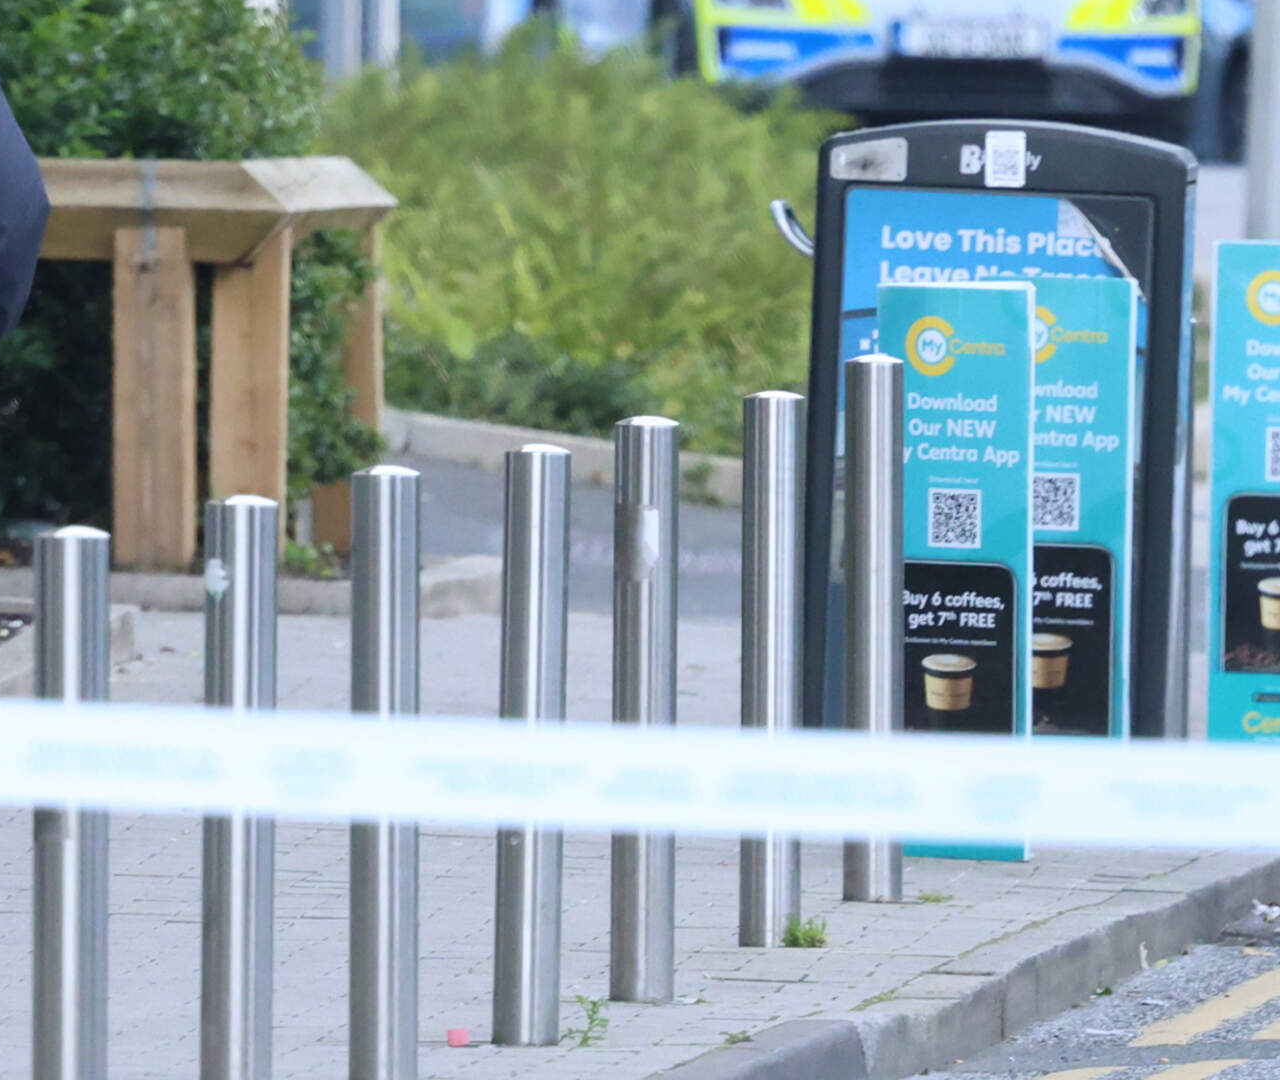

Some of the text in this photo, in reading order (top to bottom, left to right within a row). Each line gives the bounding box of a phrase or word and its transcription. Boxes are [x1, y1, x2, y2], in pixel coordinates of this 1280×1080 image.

[881, 224, 952, 251] Love
[957, 228, 1022, 255] This
[879, 260, 970, 282] Leave
[1051, 325, 1109, 344] Centra
[921, 337, 1006, 357] My Centra
[907, 392, 999, 413] Download
[1222, 384, 1250, 407] My
[1045, 404, 1097, 424] NEW
[908, 418, 998, 439] Our NEW
[1081, 430, 1120, 453] App
[917, 442, 980, 462] Centra
[983, 445, 1021, 469] App
[1235, 519, 1266, 538] Buy
[1243, 538, 1271, 557] get
[1040, 572, 1103, 591] coffees,
[903, 590, 1005, 610] Buy 6 coffees,
[1055, 592, 1094, 608] FREE
[908, 610, 997, 629] get 7th FREE
